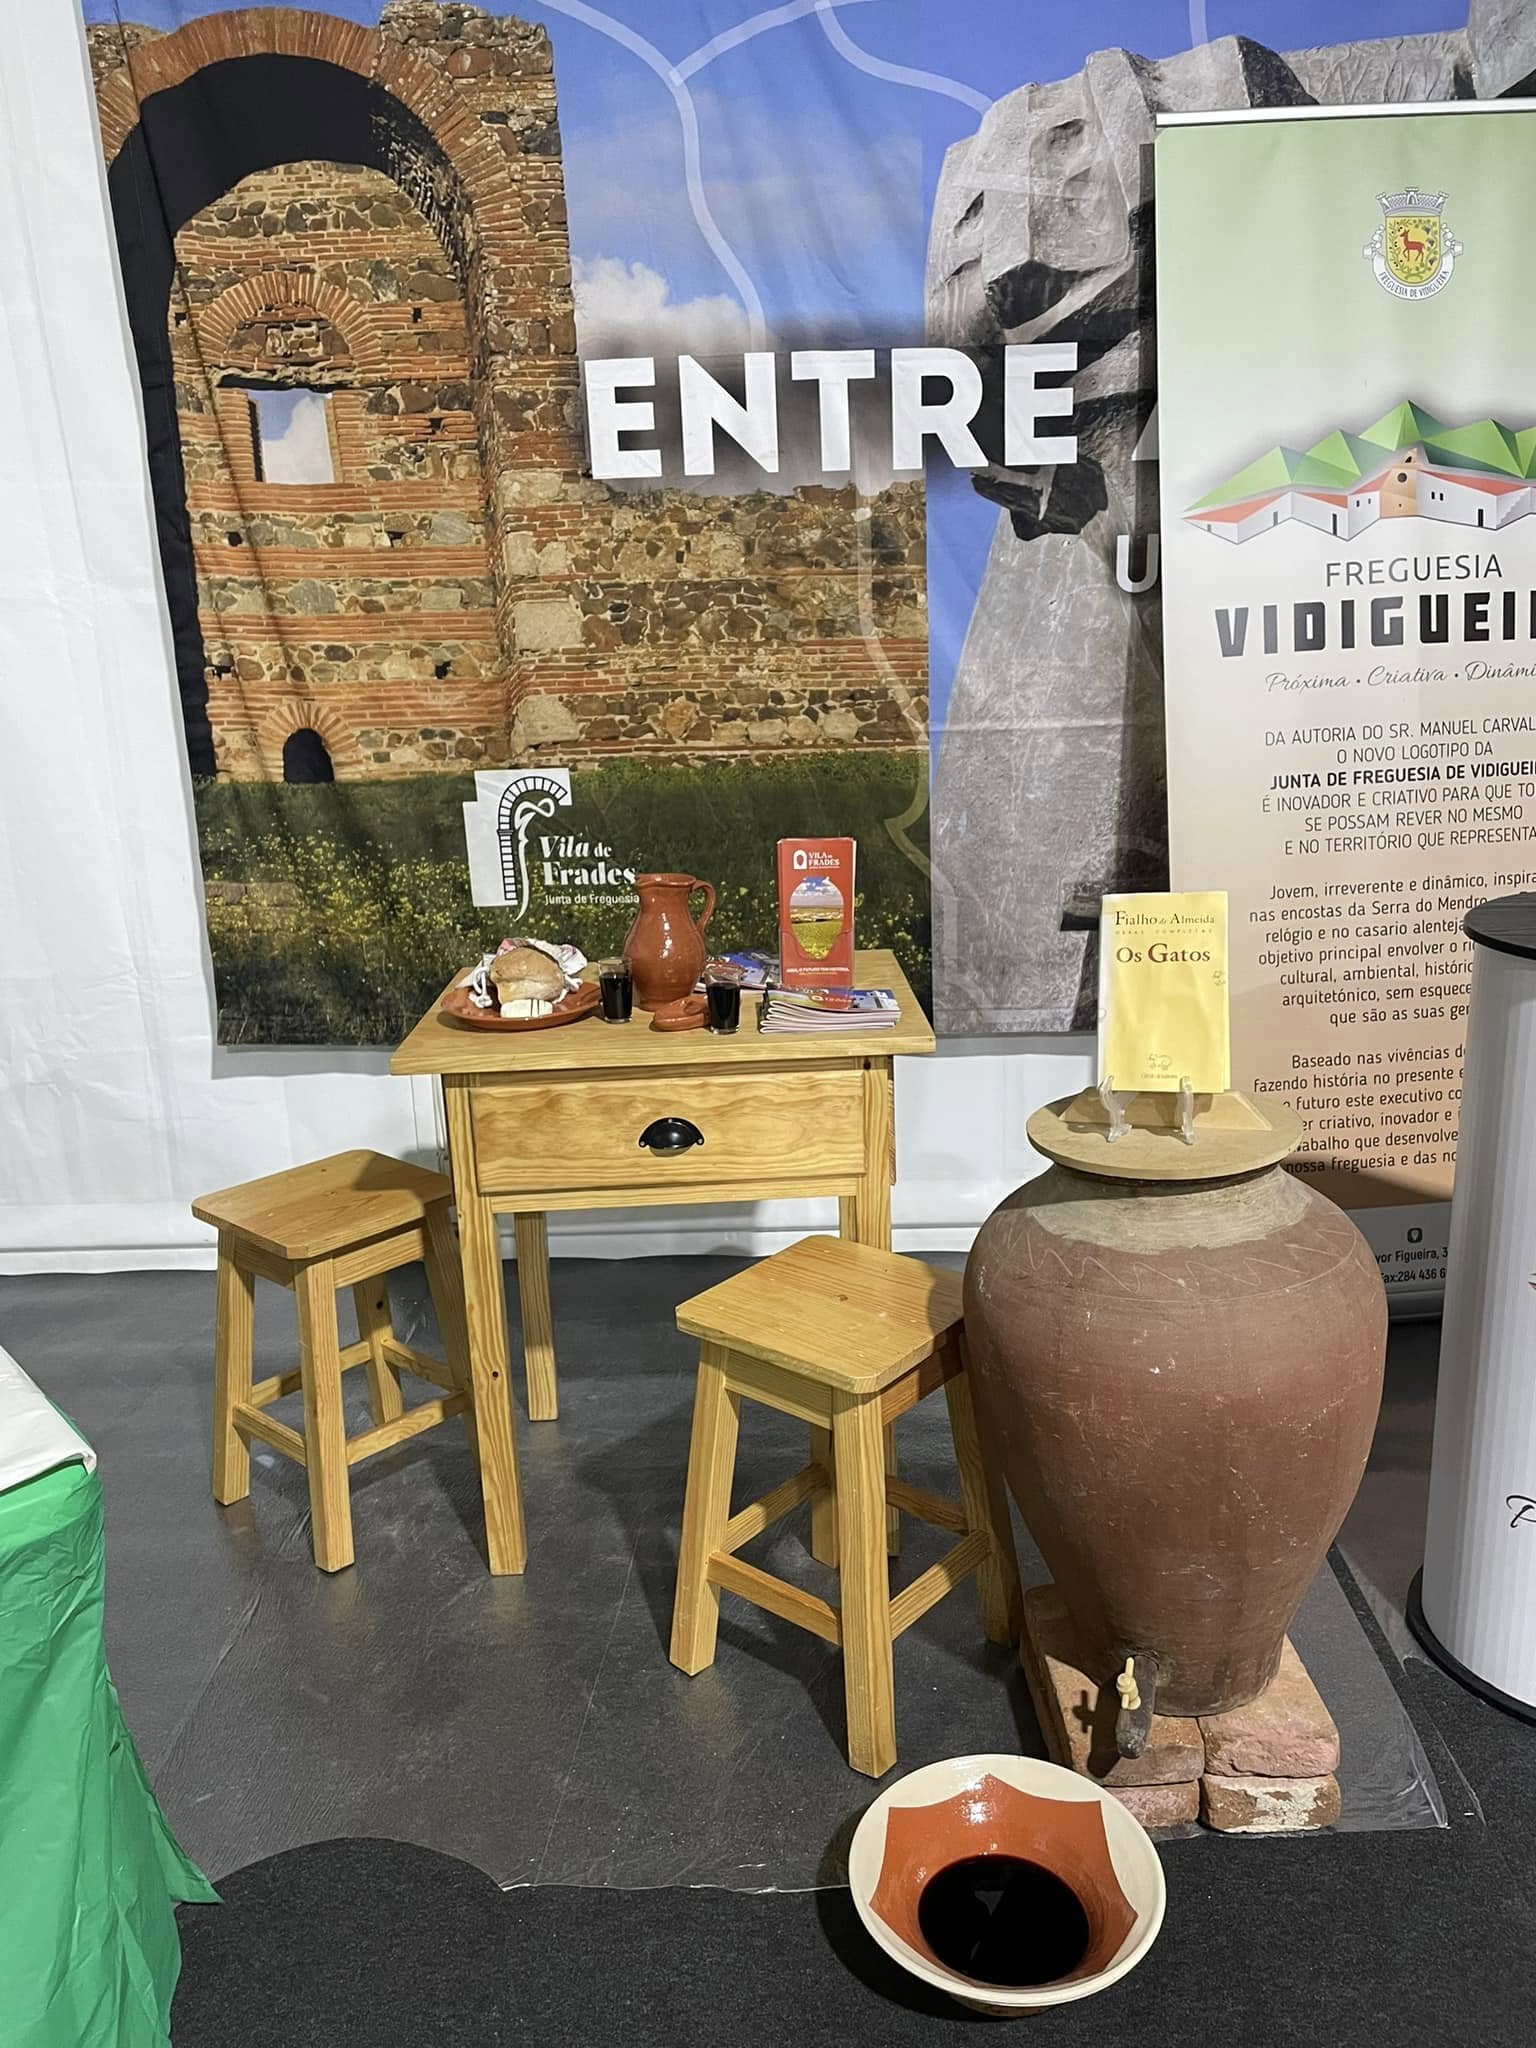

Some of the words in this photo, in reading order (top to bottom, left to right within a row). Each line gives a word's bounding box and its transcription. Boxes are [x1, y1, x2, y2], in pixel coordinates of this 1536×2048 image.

[1379, 272, 1407, 297] FREGUESIA
[1409, 288, 1418, 298] DE
[1419, 270, 1449, 297] VIDIGUEIRA
[584, 341, 1078, 480] ENTRE
[1326, 554, 1502, 587] FREGUESIA
[1215, 590, 1536, 658] VIDIGUEI
[1265, 672, 1349, 694] Próxima
[1367, 665, 1447, 686] Criativa
[1265, 731, 1286, 746] DA
[1291, 727, 1356, 744] AUTORIA
[1362, 724, 1383, 741] DO
[1389, 723, 1414, 739] SR.
[1420, 719, 1478, 737] MANUEL
[1482, 716, 1536, 734] CARVAL
[1337, 749, 1347, 764] O
[1353, 746, 1395, 763] NOVO
[1402, 741, 1469, 760] LOGOTIPO
[1474, 741, 1493, 757] DA
[1270, 774, 1321, 791] JUNTA
[1327, 771, 1347, 787] DE
[1353, 766, 1441, 785] FREGUESIA
[1446, 765, 1465, 780] DE
[1262, 794, 1271, 813] É
[1277, 793, 1351, 811] INOVADOR
[1358, 792, 1366, 807] E
[1372, 787, 1438, 806] CRIATIVO
[1442, 786, 1480, 802] PARA
[1485, 783, 1512, 801] QUE
[1305, 817, 1322, 832] SE
[1328, 813, 1390, 831] POSSAM
[1396, 809, 1442, 827] REVER
[1448, 808, 1468, 823] NO
[1473, 805, 1523, 822] MESMO
[540, 835, 590, 858] Vila
[593, 842, 612, 858] de
[1285, 840, 1293, 855] E
[1299, 838, 1320, 854] NO
[1325, 831, 1412, 853] TERRITÓRIO
[1417, 831, 1445, 850] QUE
[1450, 826, 1536, 846] REPRESENTA
[542, 861, 636, 886] Frades
[1270, 885, 1318, 900] Jovem,
[1324, 879, 1404, 897] irreverente
[1409, 880, 1417, 891] e
[1422, 873, 1488, 891] dinâmico,
[544, 895, 571, 906] Junta
[574, 894, 588, 905] de
[589, 893, 640, 907] Freguesia
[1249, 909, 1276, 922] nas
[1281, 904, 1342, 921] encostas
[1348, 901, 1365, 917] da
[1371, 900, 1410, 915] Serra
[1415, 898, 1433, 912] do
[1115, 910, 1157, 925] Fialho
[1170, 913, 1215, 924] Almeida
[1265, 927, 1313, 946] relógio
[1318, 928, 1326, 940] e
[1332, 926, 1349, 939] no
[1355, 920, 1407, 937] casario
[1116, 947, 1142, 963] Os
[1148, 943, 1211, 963] Gatos
[1258, 949, 1313, 968] objetivo
[1319, 943, 1381, 965] principal
[1387, 941, 1445, 957] envolver
[1449, 942, 1457, 953] o
[1280, 968, 1337, 986] cultural,
[1343, 963, 1419, 982] ambiental,
[1282, 989, 1380, 1009] arquitetónico,
[1386, 987, 1414, 1000] sem
[1420, 983, 1471, 999] esquece
[1330, 1012, 1356, 1027] que
[1362, 1008, 1387, 1023] são
[1392, 1009, 1408, 1021] as
[1413, 1006, 1445, 1019] suas
[1292, 1052, 1351, 1069] Baseado
[1357, 1052, 1382, 1065] nas
[1387, 1047, 1450, 1063] vivências
[1455, 1044, 1466, 1061] d
[1254, 1076, 1308, 1093] fazendo
[1313, 1071, 1368, 1088] história
[1373, 1073, 1390, 1085] no
[1396, 1067, 1454, 1086] presente
[1296, 1093, 1340, 1110] futuro
[1346, 1094, 1374, 1107] este
[1380, 1089, 1443, 1105] executivo
[1319, 1114, 1375, 1130] criativo,
[1380, 1109, 1440, 1125] inovador
[1444, 1110, 1452, 1120] e
[1354, 1135, 1380, 1150] que
[1386, 1128, 1459, 1146] desenvolve
[1286, 1160, 1325, 1174] nossa
[1331, 1153, 1395, 1174] freguesia
[1401, 1155, 1408, 1166] e
[1413, 1150, 1437, 1164] das
[1395, 1249, 1440, 1264] Figueira,
[1418, 1268, 1437, 1280] 436
